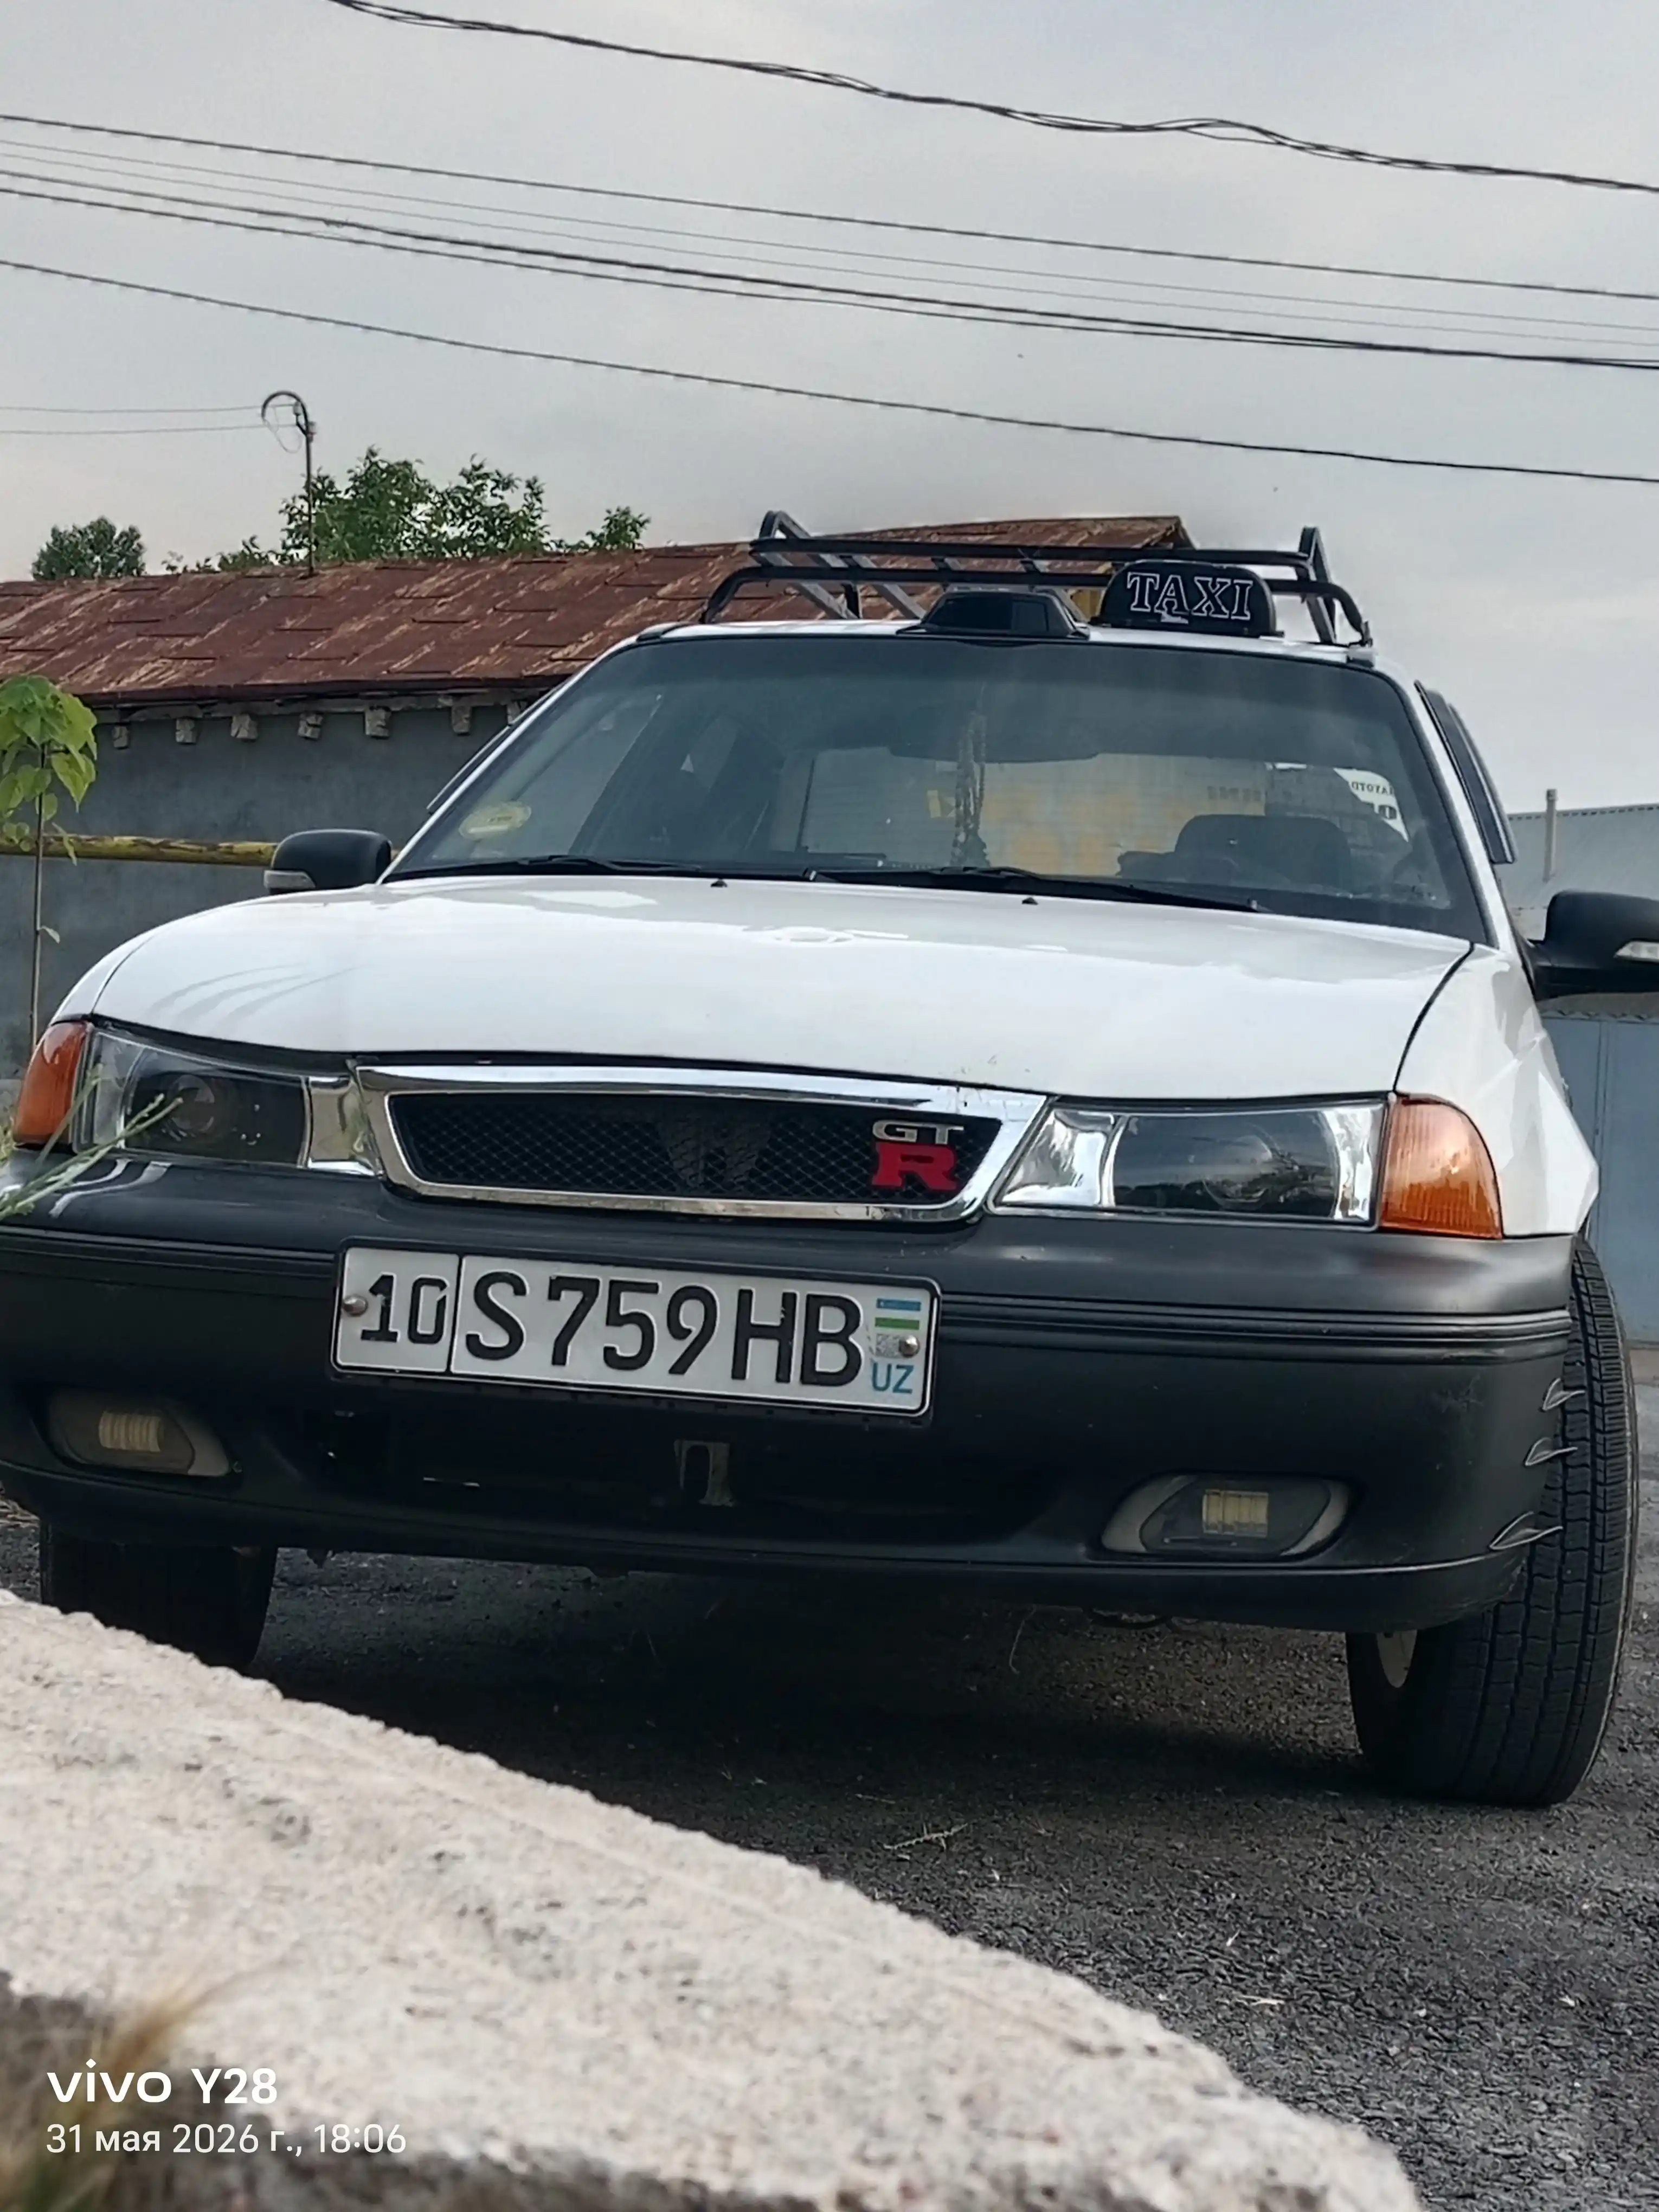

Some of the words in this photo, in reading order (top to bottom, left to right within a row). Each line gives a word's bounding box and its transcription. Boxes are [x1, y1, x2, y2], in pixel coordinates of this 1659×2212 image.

[1127, 572, 1253, 621] TAXI
[872, 1120, 964, 1144] GT
[872, 1142, 958, 1191] R
[361, 1274, 448, 1345] 10
[872, 1362, 914, 1394] UZ
